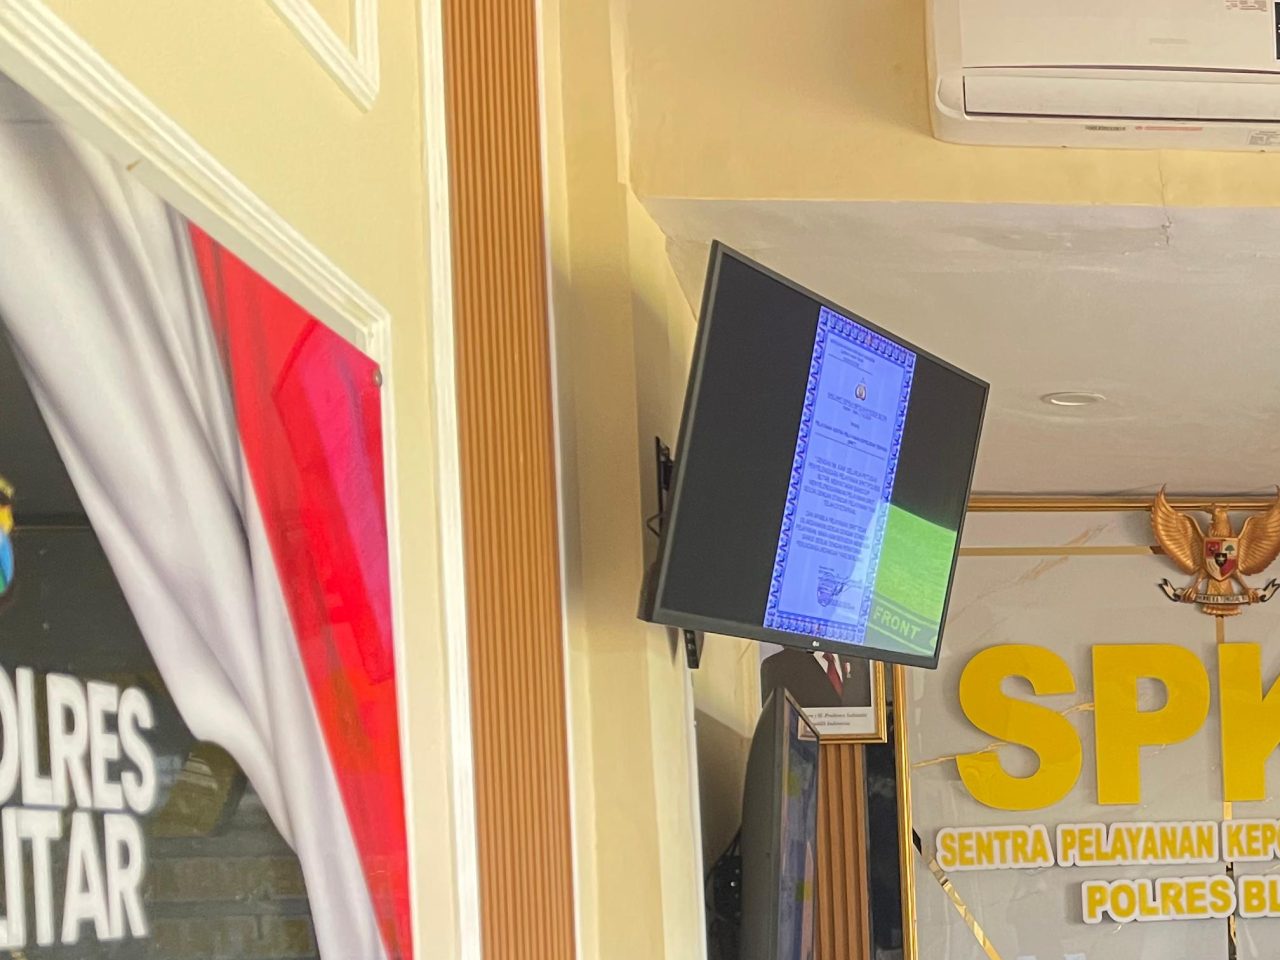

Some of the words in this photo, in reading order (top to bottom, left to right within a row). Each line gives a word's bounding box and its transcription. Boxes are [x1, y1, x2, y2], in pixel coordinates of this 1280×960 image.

[873, 606, 921, 640] FRONT
[940, 826, 1049, 867] SENTRA
[1060, 822, 1215, 864] PELAYANAN
[0, 807, 150, 951] ITAR
[1086, 876, 1232, 921] POLRES
